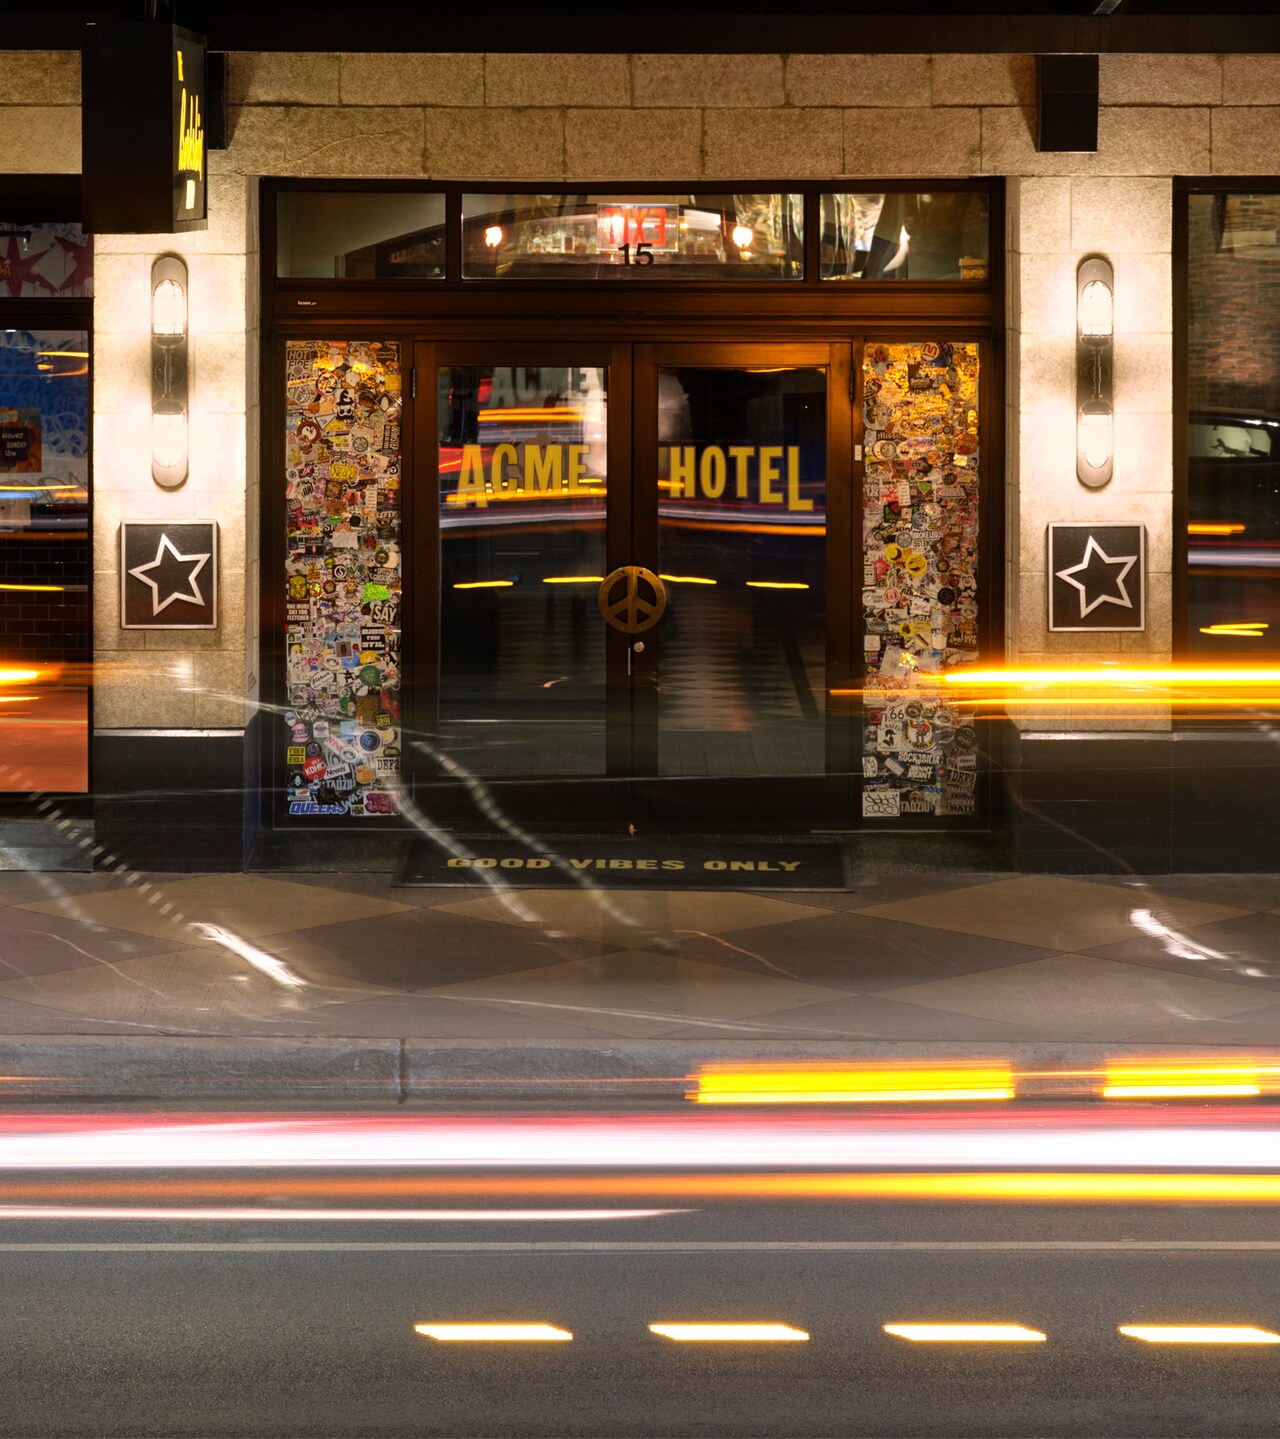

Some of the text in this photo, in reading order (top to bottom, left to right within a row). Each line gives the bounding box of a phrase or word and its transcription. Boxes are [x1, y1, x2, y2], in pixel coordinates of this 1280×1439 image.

[618, 242, 655, 268] 15
[288, 350, 308, 360] HOT
[452, 443, 814, 511] ACME HOTEL
[373, 605, 397, 622] SAY
[446, 856, 802, 873] GOOD VIBES ONLY
